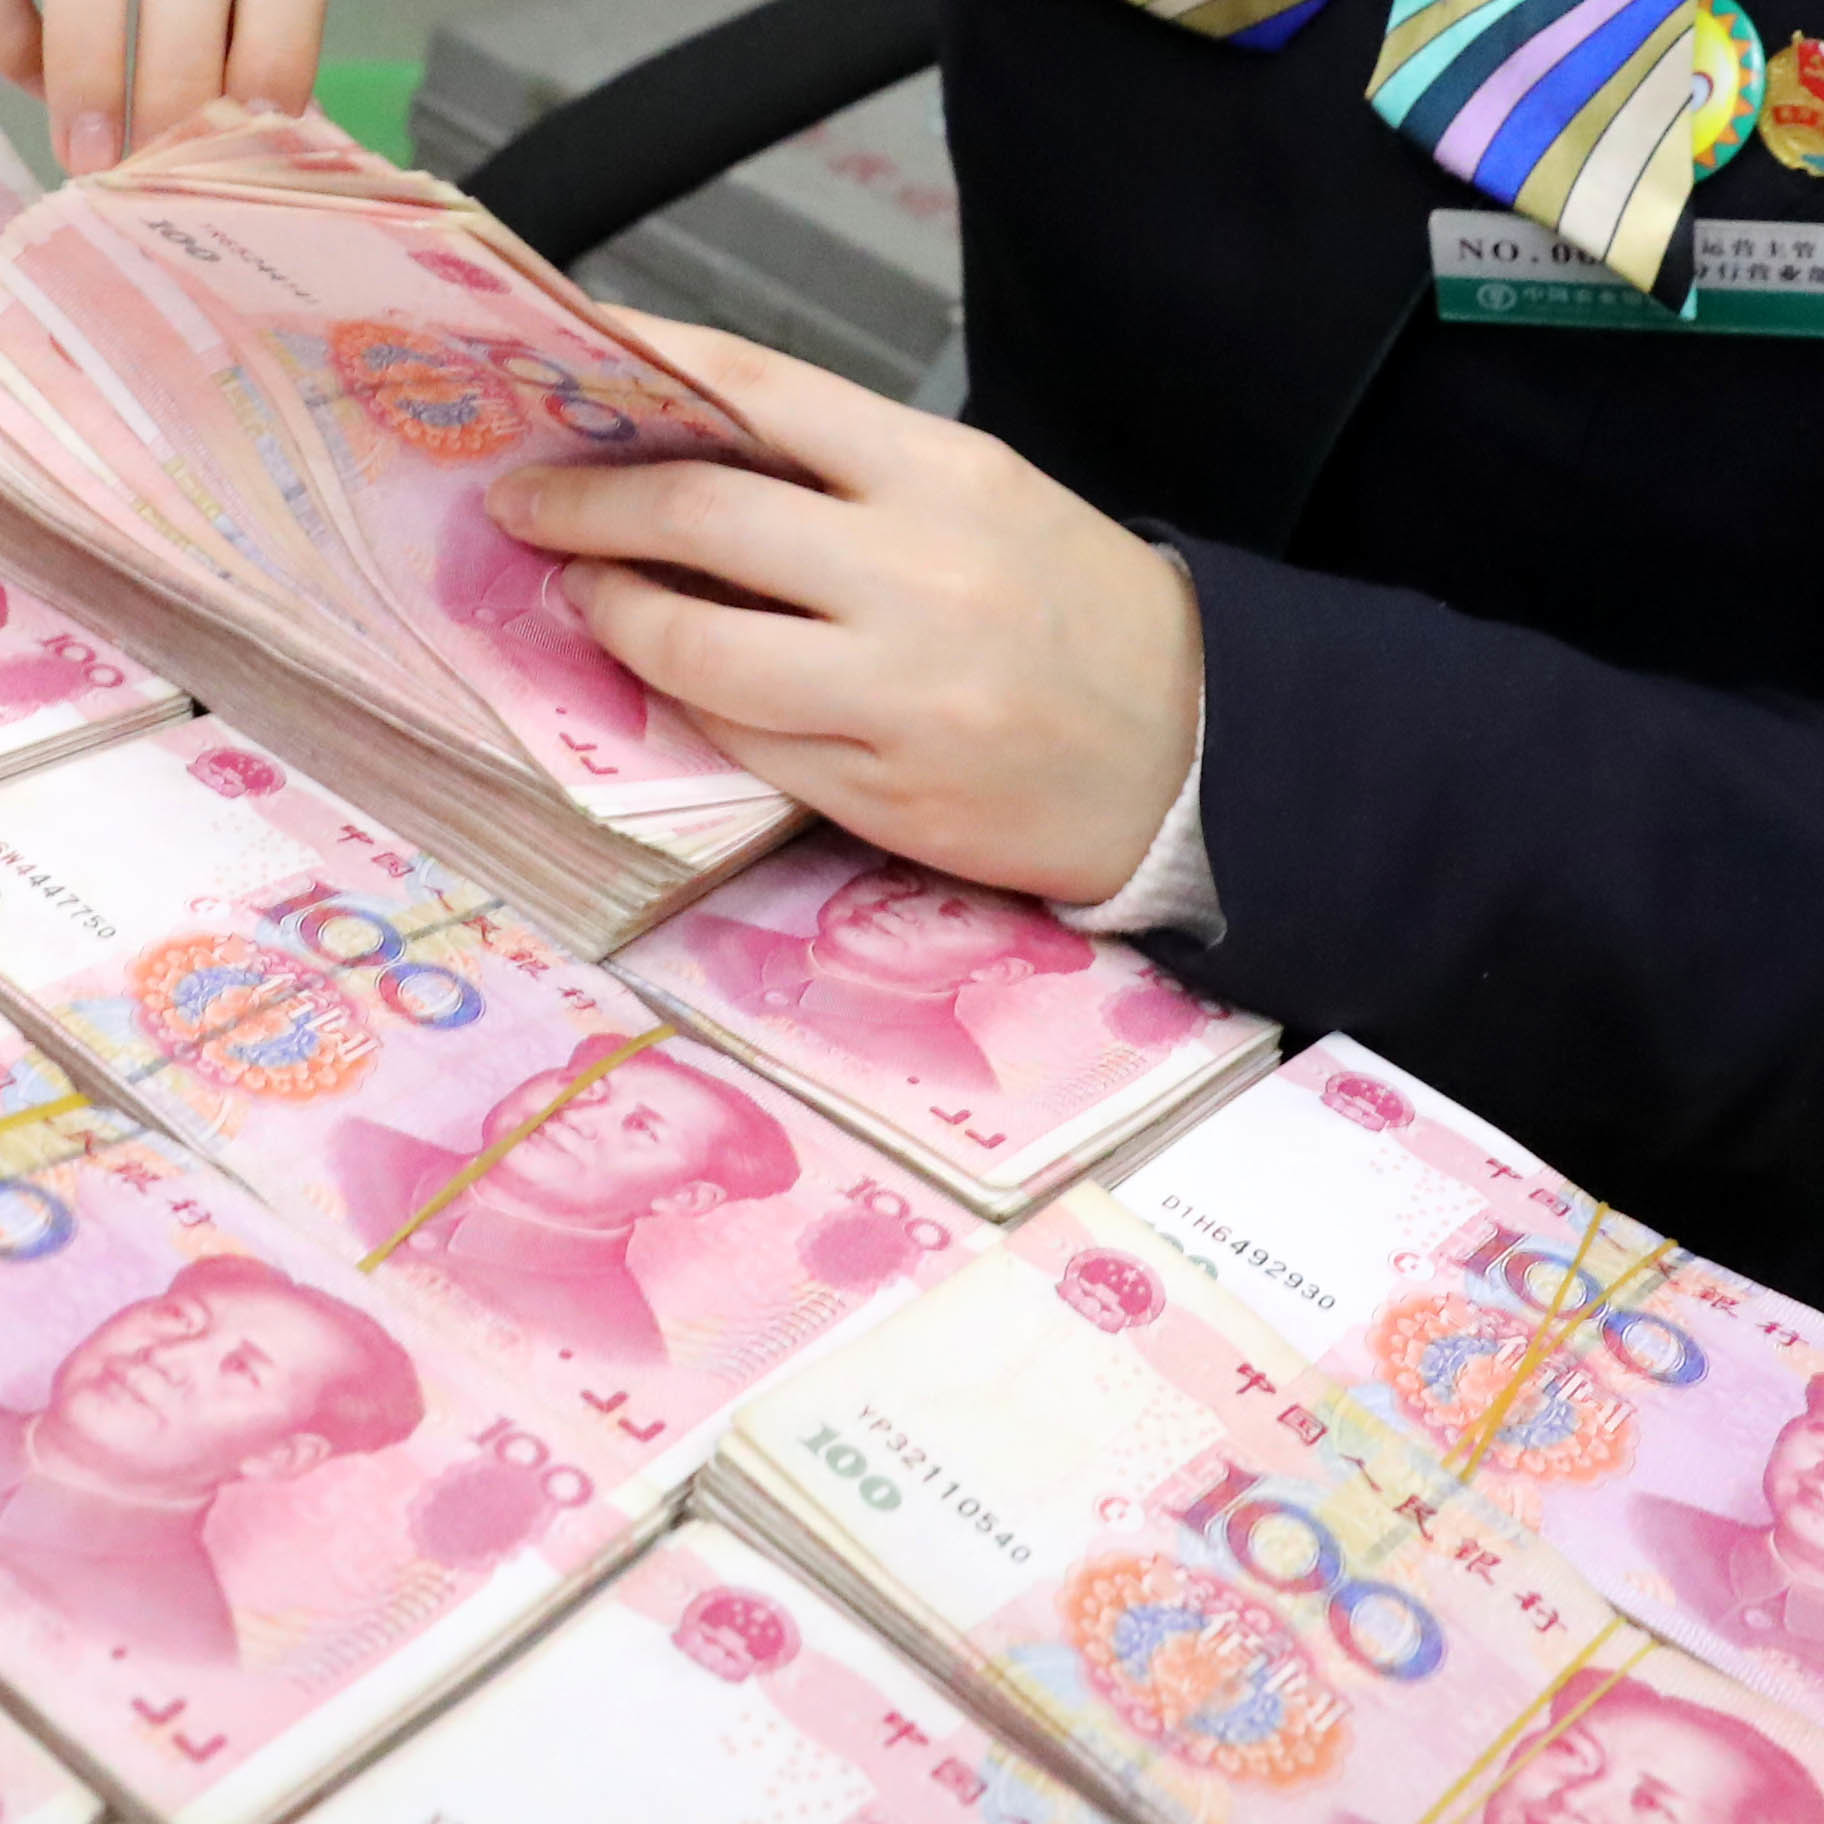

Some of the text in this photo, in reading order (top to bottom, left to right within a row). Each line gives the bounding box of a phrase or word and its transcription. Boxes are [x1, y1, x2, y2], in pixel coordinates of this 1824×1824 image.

[41, 632, 125, 688] 100
[255, 878, 486, 1030] 100
[845, 1177, 951, 1252] 100
[1160, 1194, 1337, 1312] D1H6492930
[1461, 1217, 1710, 1389] 100
[470, 1416, 594, 1509] 100
[796, 1421, 903, 1513] 100
[1233, 1362, 1568, 1636] 中国人民银行
[1176, 1458, 1448, 1680] 100
